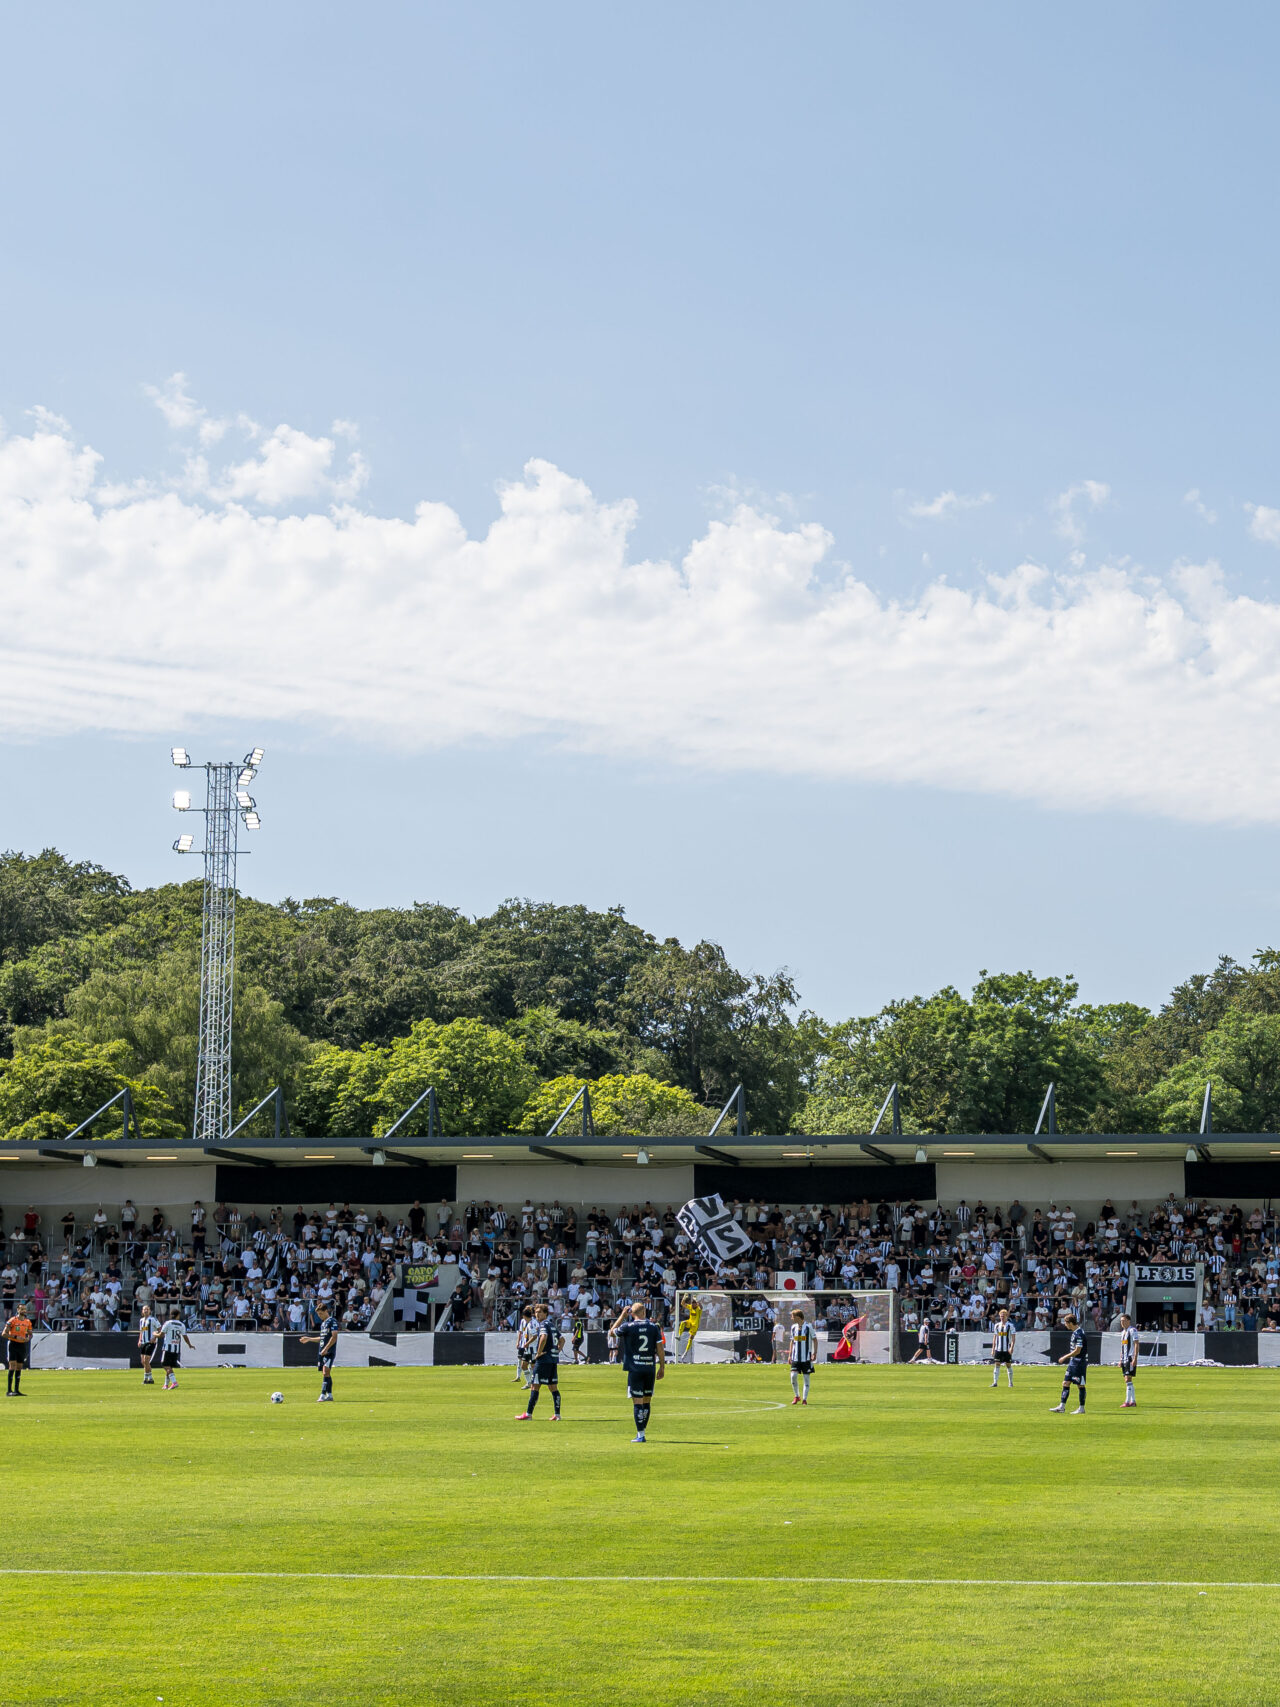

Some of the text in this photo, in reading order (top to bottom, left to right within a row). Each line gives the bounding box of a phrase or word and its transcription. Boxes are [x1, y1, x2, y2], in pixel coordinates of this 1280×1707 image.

[408, 1267, 433, 1275] CAPO
[1137, 1267, 1195, 1280] LF 15
[172, 1330, 181, 1340] 18
[639, 1335, 648, 1351] 2
